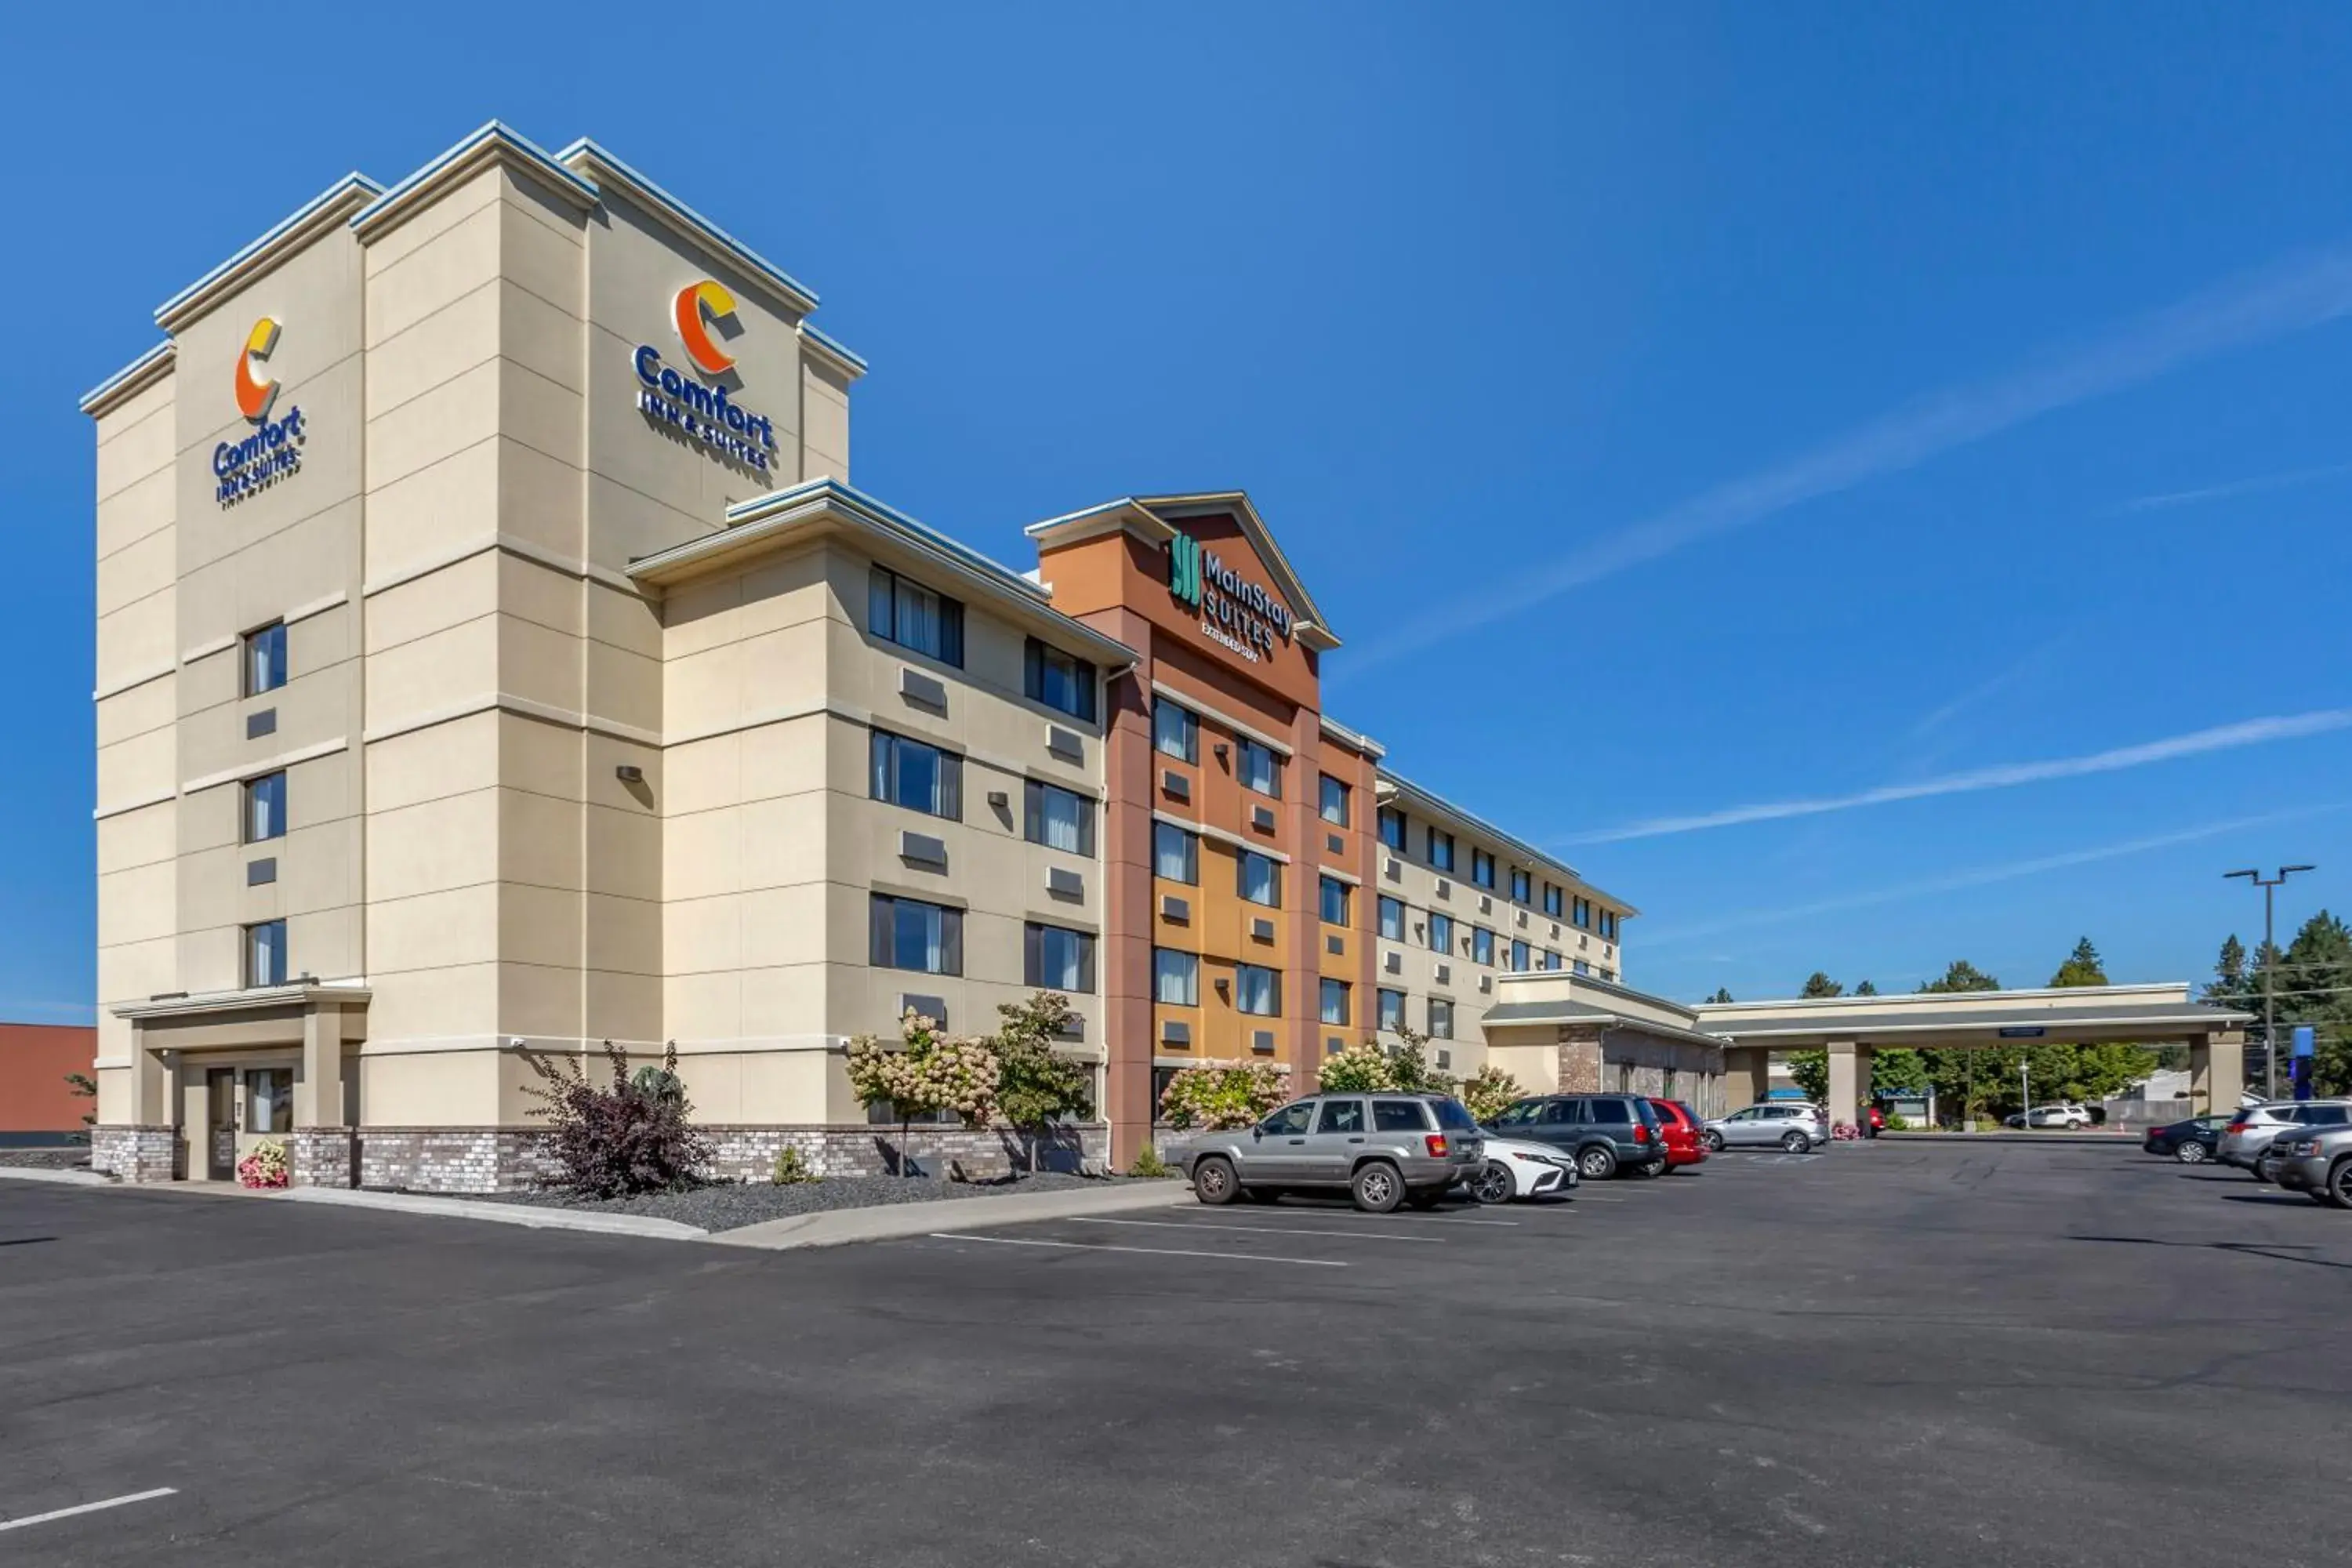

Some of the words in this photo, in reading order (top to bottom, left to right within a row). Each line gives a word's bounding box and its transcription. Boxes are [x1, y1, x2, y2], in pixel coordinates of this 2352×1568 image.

[631, 345, 773, 448] Comfort
[637, 390, 679, 425] INN
[698, 423, 767, 470] SUITES
[213, 405, 300, 477] Comfort
[1205, 550, 1293, 637] MainStay
[1206, 591, 1272, 650] SUITES
